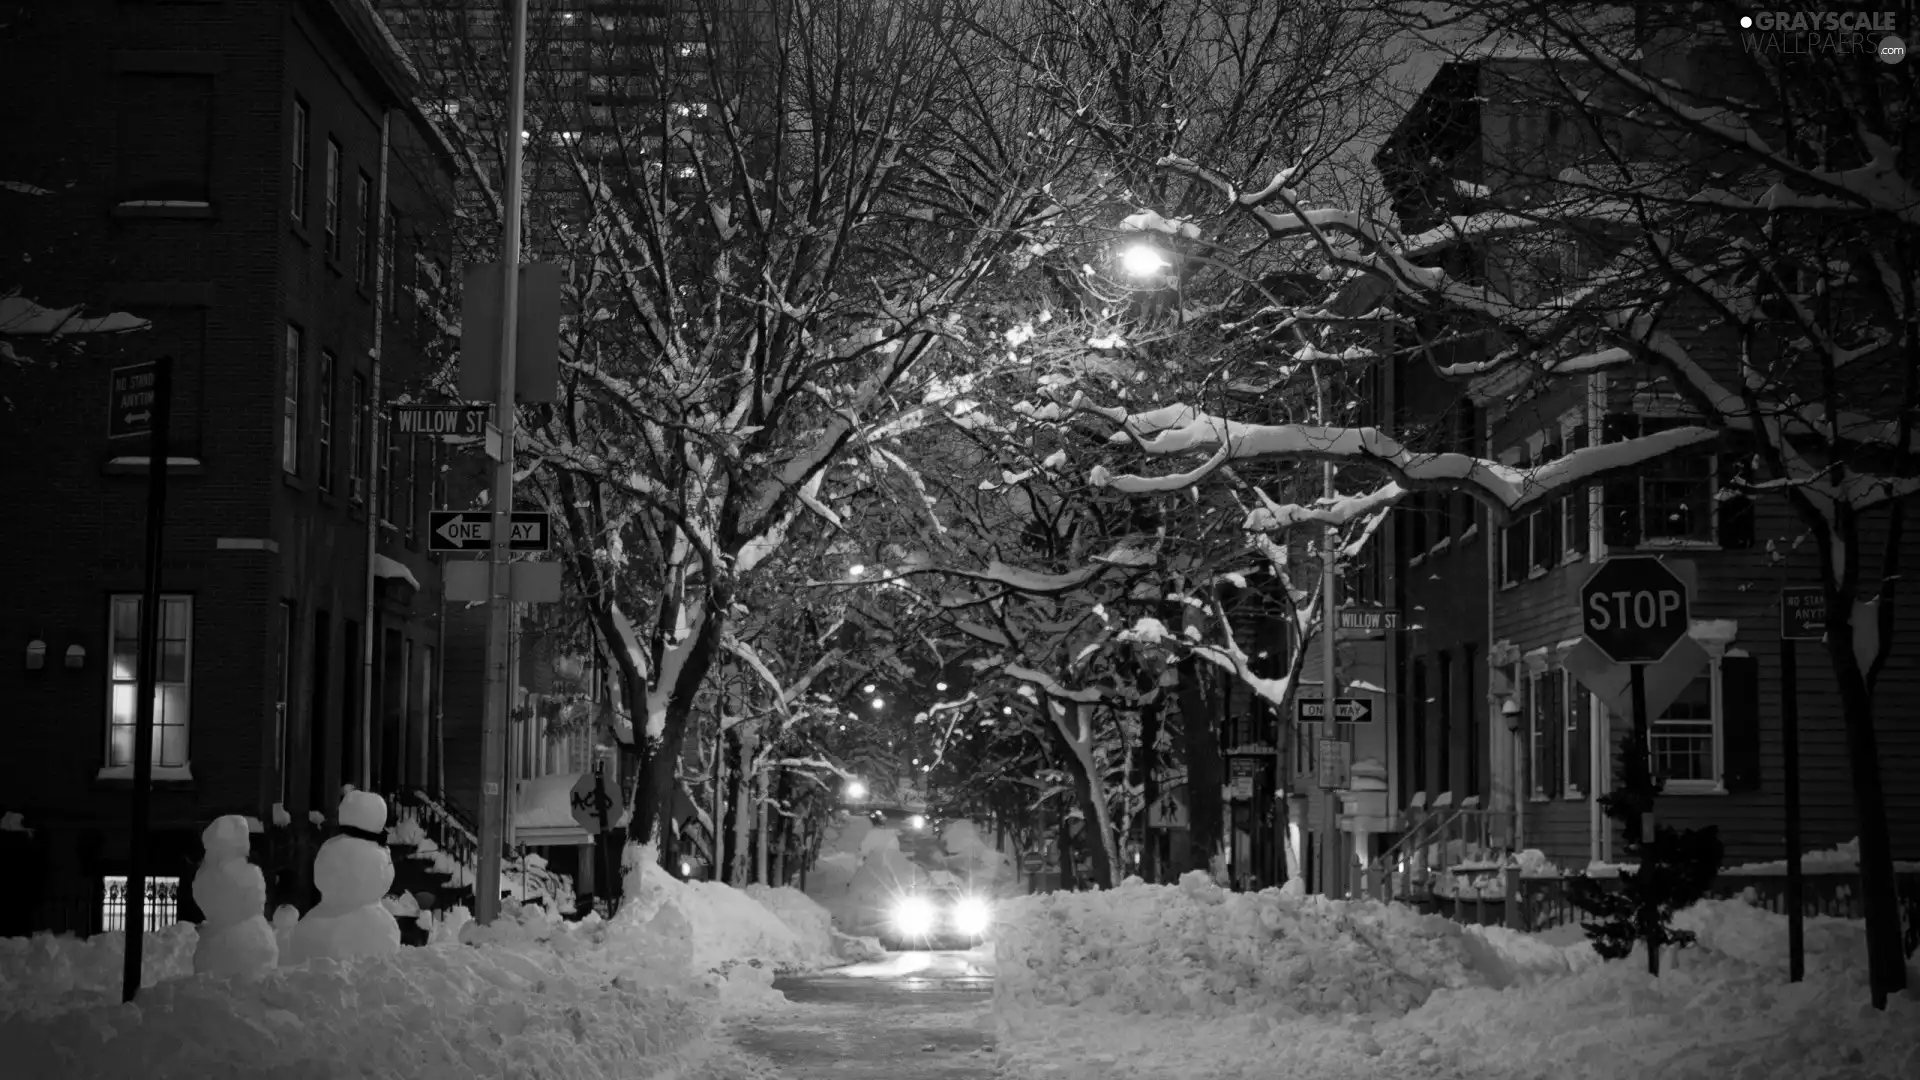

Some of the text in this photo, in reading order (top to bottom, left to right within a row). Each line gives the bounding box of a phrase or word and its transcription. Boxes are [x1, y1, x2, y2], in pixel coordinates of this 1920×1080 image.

[115, 372, 155, 391] NO STAND
[120, 389, 155, 409] ANYTIM
[400, 410, 485, 433] WILLOW ST
[448, 524, 533, 538] ONE AY
[1589, 589, 1680, 631] STOP
[1786, 596, 1800, 607] NO
[1341, 613, 1397, 629] WILLOW ST
[1309, 705, 1360, 716] ON WAY
